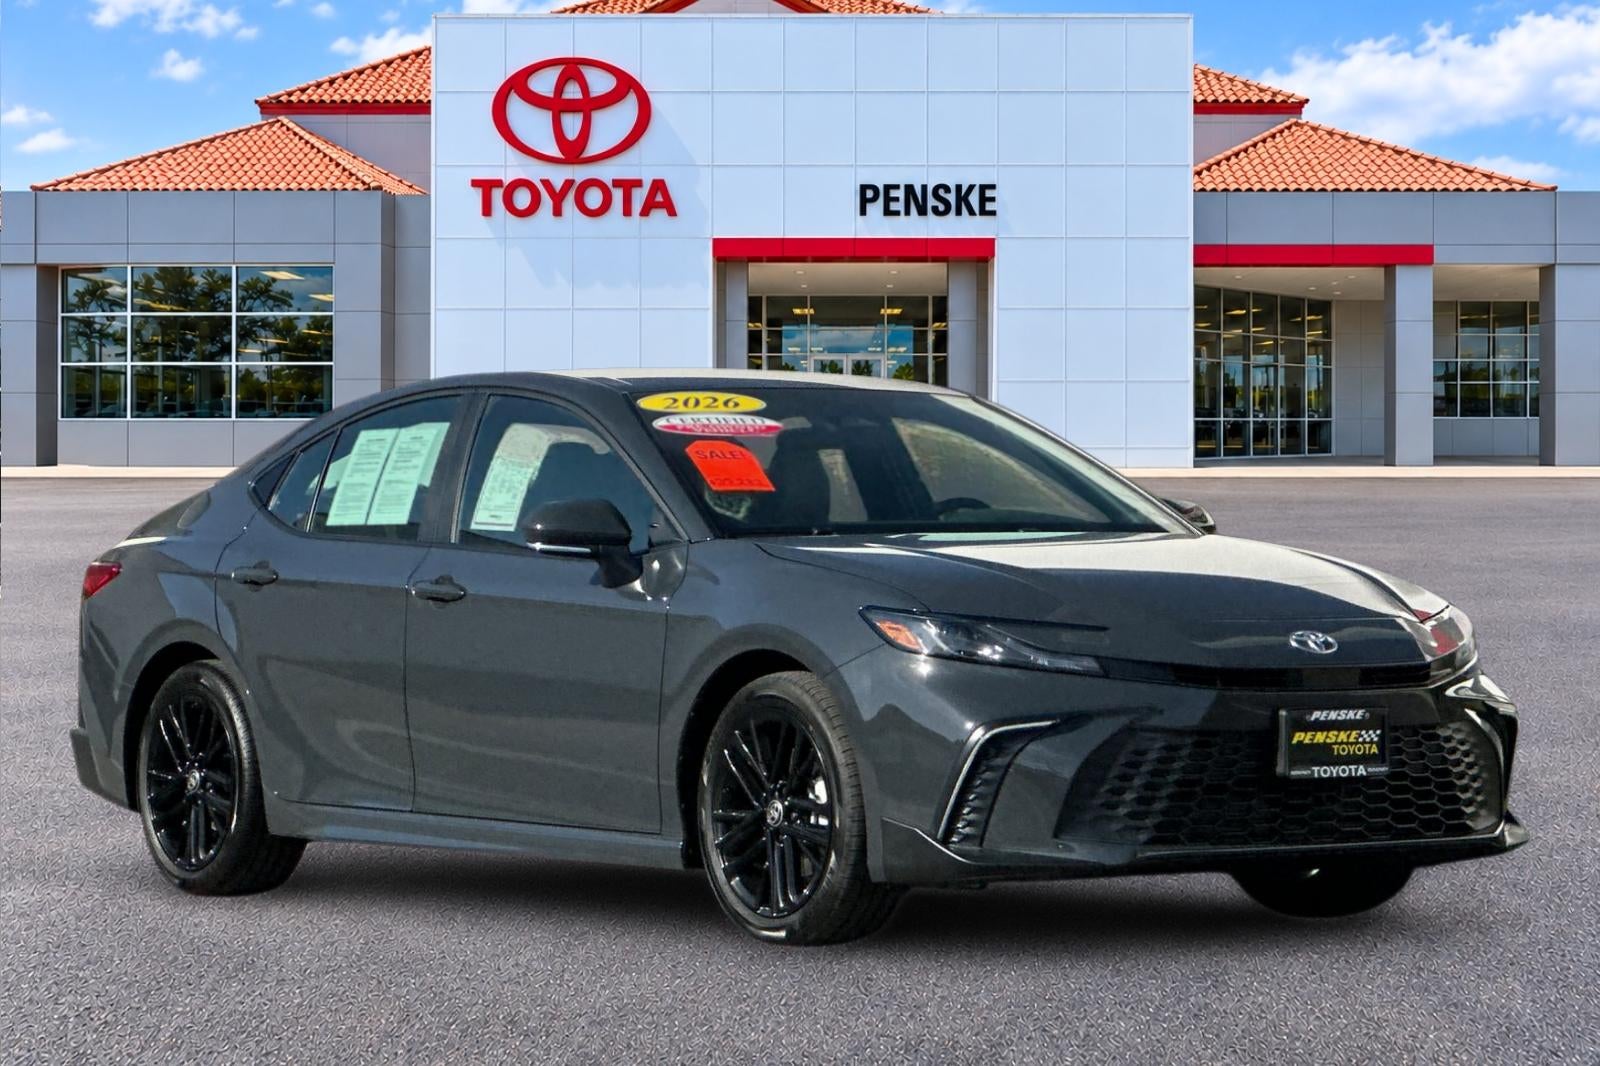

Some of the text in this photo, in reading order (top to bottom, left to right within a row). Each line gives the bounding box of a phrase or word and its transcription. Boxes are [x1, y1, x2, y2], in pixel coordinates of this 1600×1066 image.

[471, 178, 677, 218] TOYOTA
[859, 183, 998, 217] PENSKE
[664, 396, 740, 410] 2026
[1311, 709, 1365, 721] PENSKE
[1292, 730, 1360, 744] PENSKE
[1332, 744, 1378, 755] TOYOTA
[1312, 765, 1367, 778] TOYOTA
